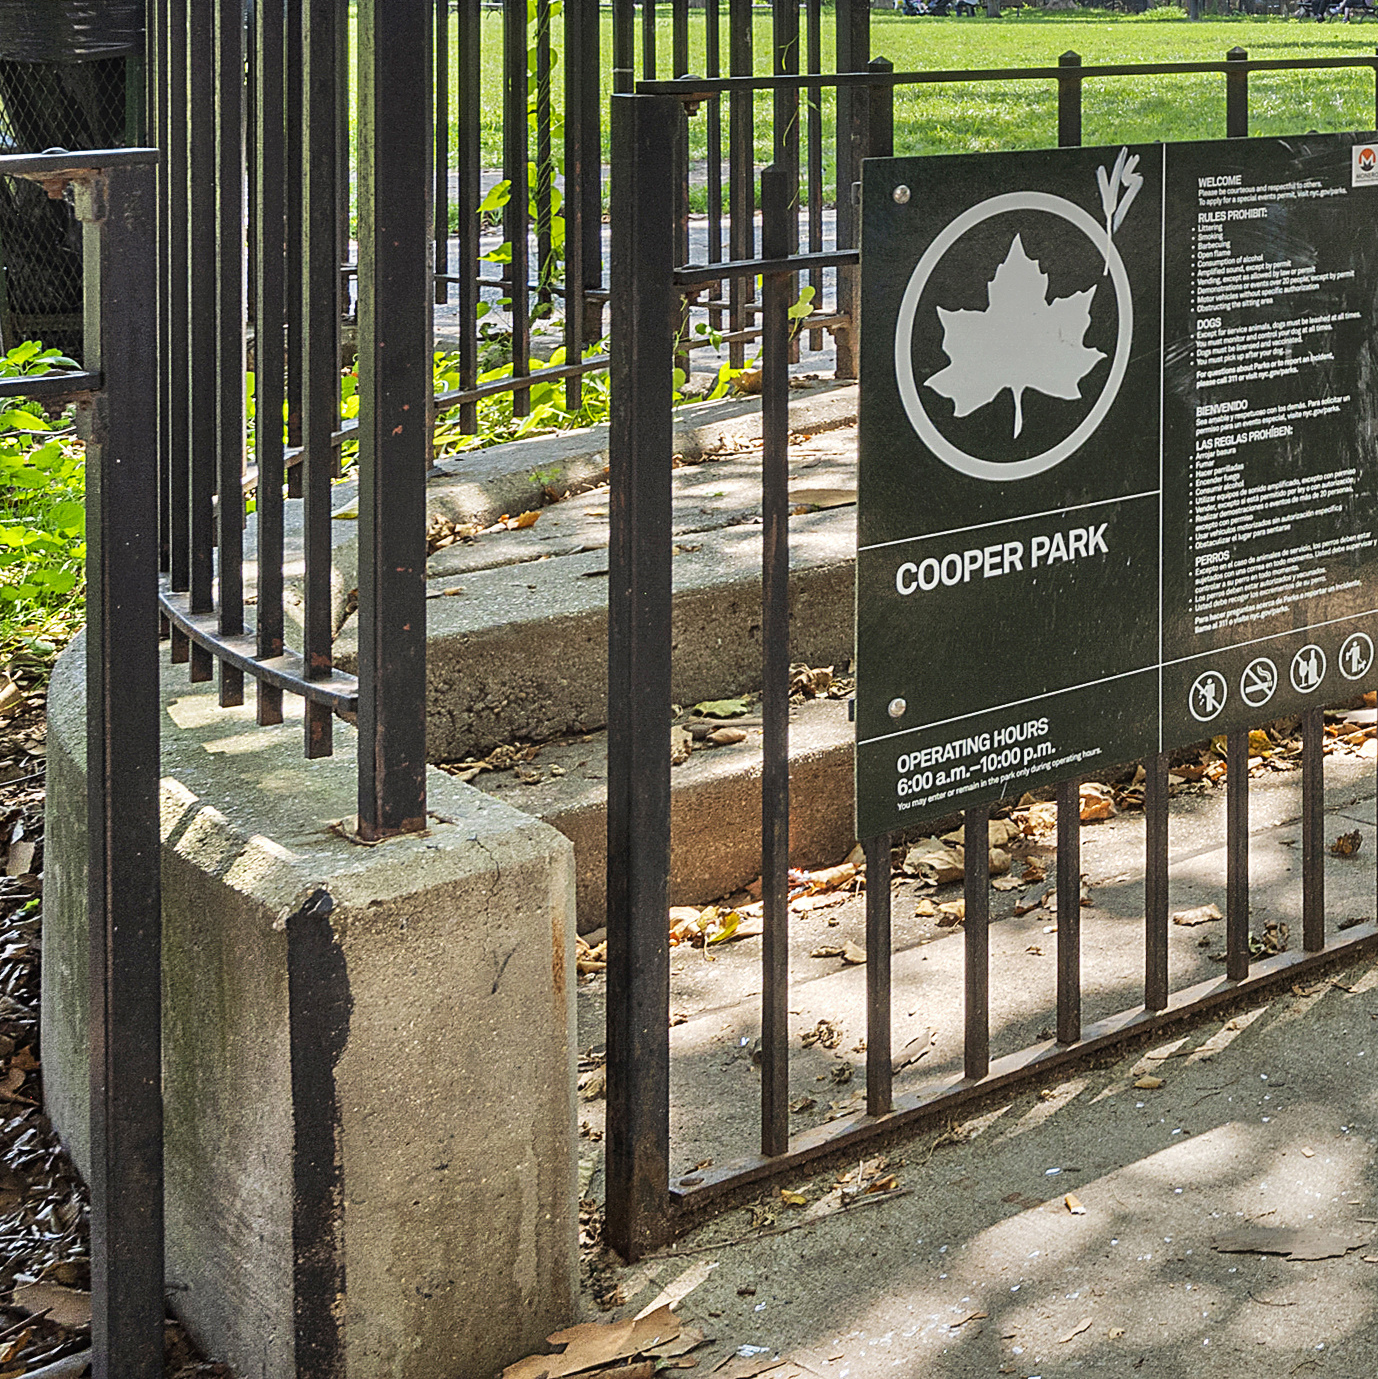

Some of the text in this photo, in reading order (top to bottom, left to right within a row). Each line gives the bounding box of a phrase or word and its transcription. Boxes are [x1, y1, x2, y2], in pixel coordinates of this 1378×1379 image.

[1198, 175, 1241, 188] WELCOME
[1198, 207, 1267, 223] RULES PROHIBIT:
[1197, 317, 1221, 330] DOGS
[1196, 399, 1247, 417] BIENVENIDO
[1196, 438, 1213, 451] LAS
[1214, 433, 1248, 448] REGLAS
[895, 522, 1110, 596] COOPER PARK
[1195, 550, 1229, 567] PERROS
[897, 717, 1049, 774] OPERATING HOURS
[897, 771, 933, 797] 6:00
[1023, 739, 1056, 763] p.m.
